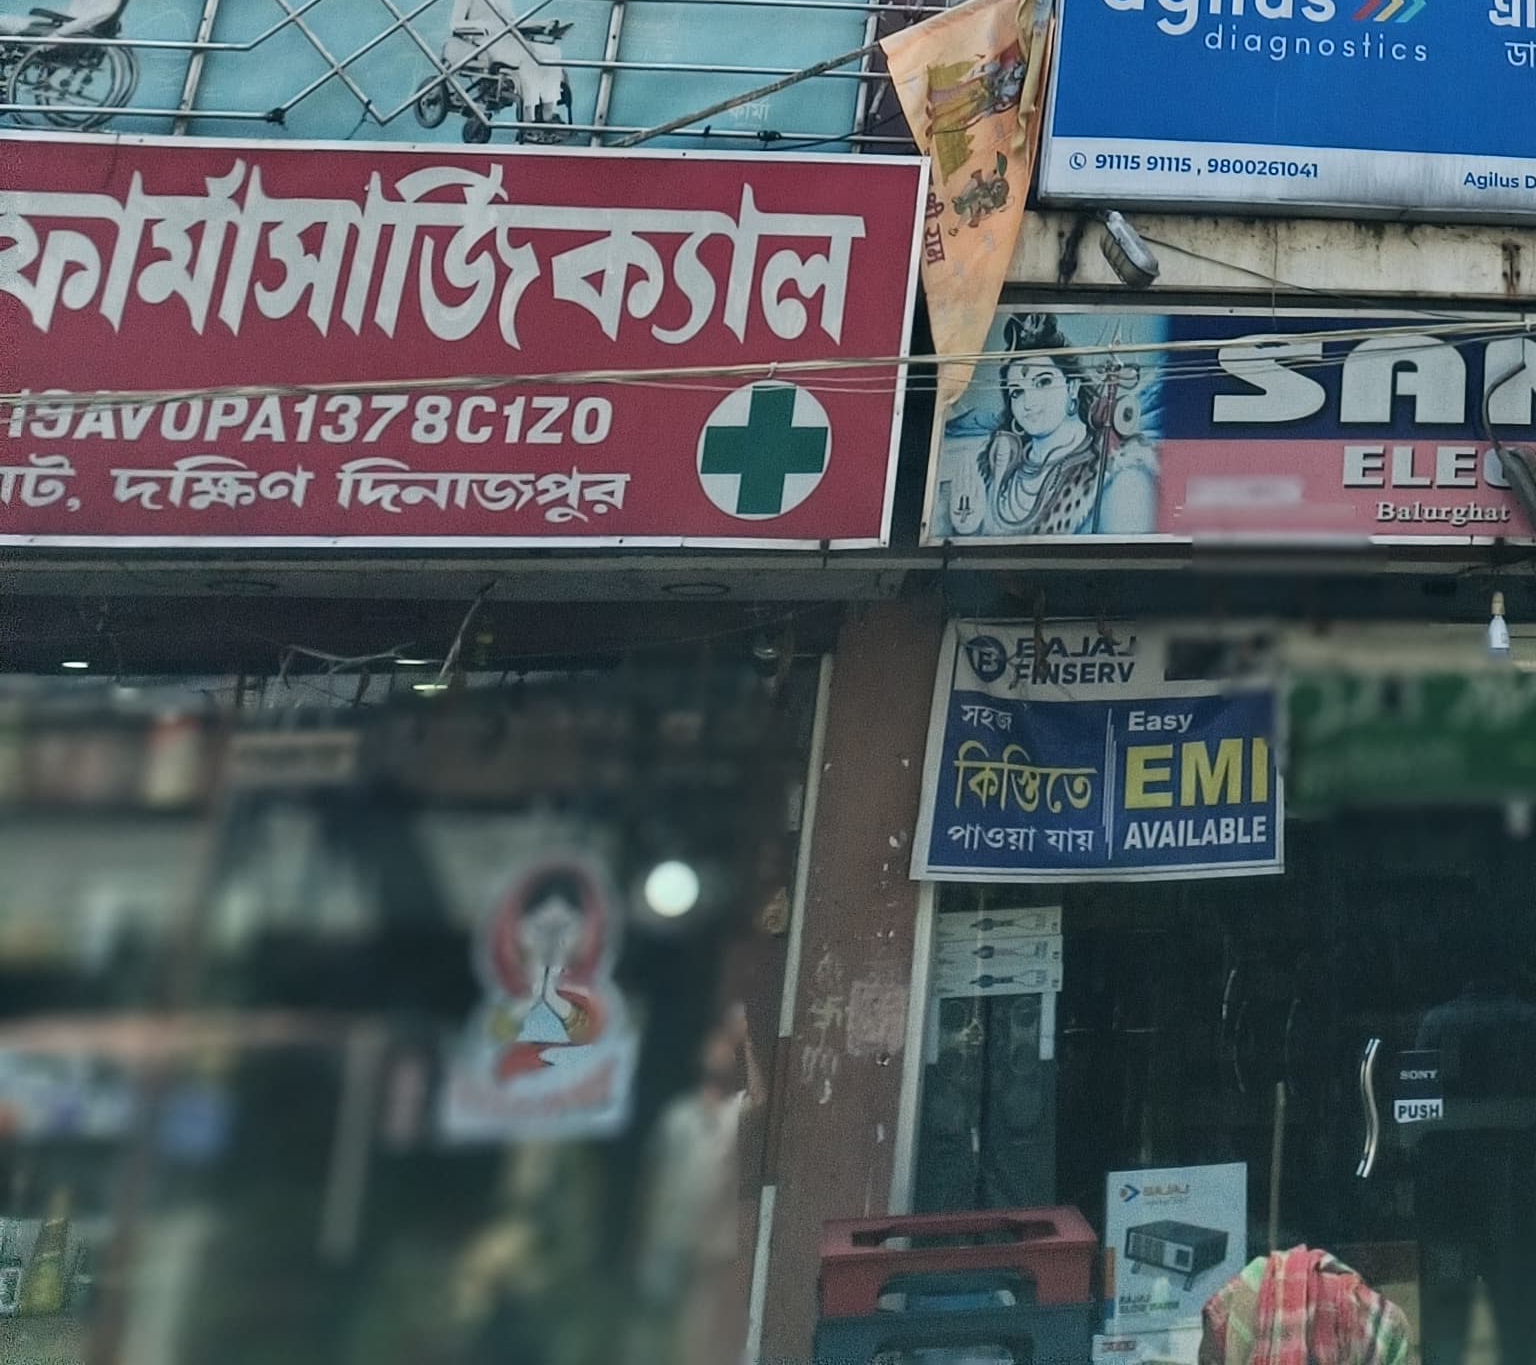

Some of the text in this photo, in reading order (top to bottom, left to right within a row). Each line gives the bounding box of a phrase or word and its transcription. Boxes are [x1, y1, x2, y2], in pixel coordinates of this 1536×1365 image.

[1204, 24, 1428, 62] diagnostics
[1095, 153, 1140, 170] 91115
[1146, 155, 1192, 172] 91115
[1207, 158, 1318, 178] 9800261041
[1463, 171, 1519, 190] Agilus
[110, 455, 315, 511] দক্ষিণ
[336, 457, 631, 523] দিনাজপুর
[1376, 501, 1510, 527] Balurghat
[1016, 635, 1137, 659] BAJAJ
[960, 704, 1013, 733] সহজ
[1128, 711, 1193, 734] Easy
[1124, 737, 1269, 810] EMI
[947, 823, 1094, 853] পাওয়া যায়
[1123, 815, 1267, 851] AVAILABLE
[1400, 1069, 1438, 1080] SONY
[1398, 1103, 1440, 1120] PUSH
